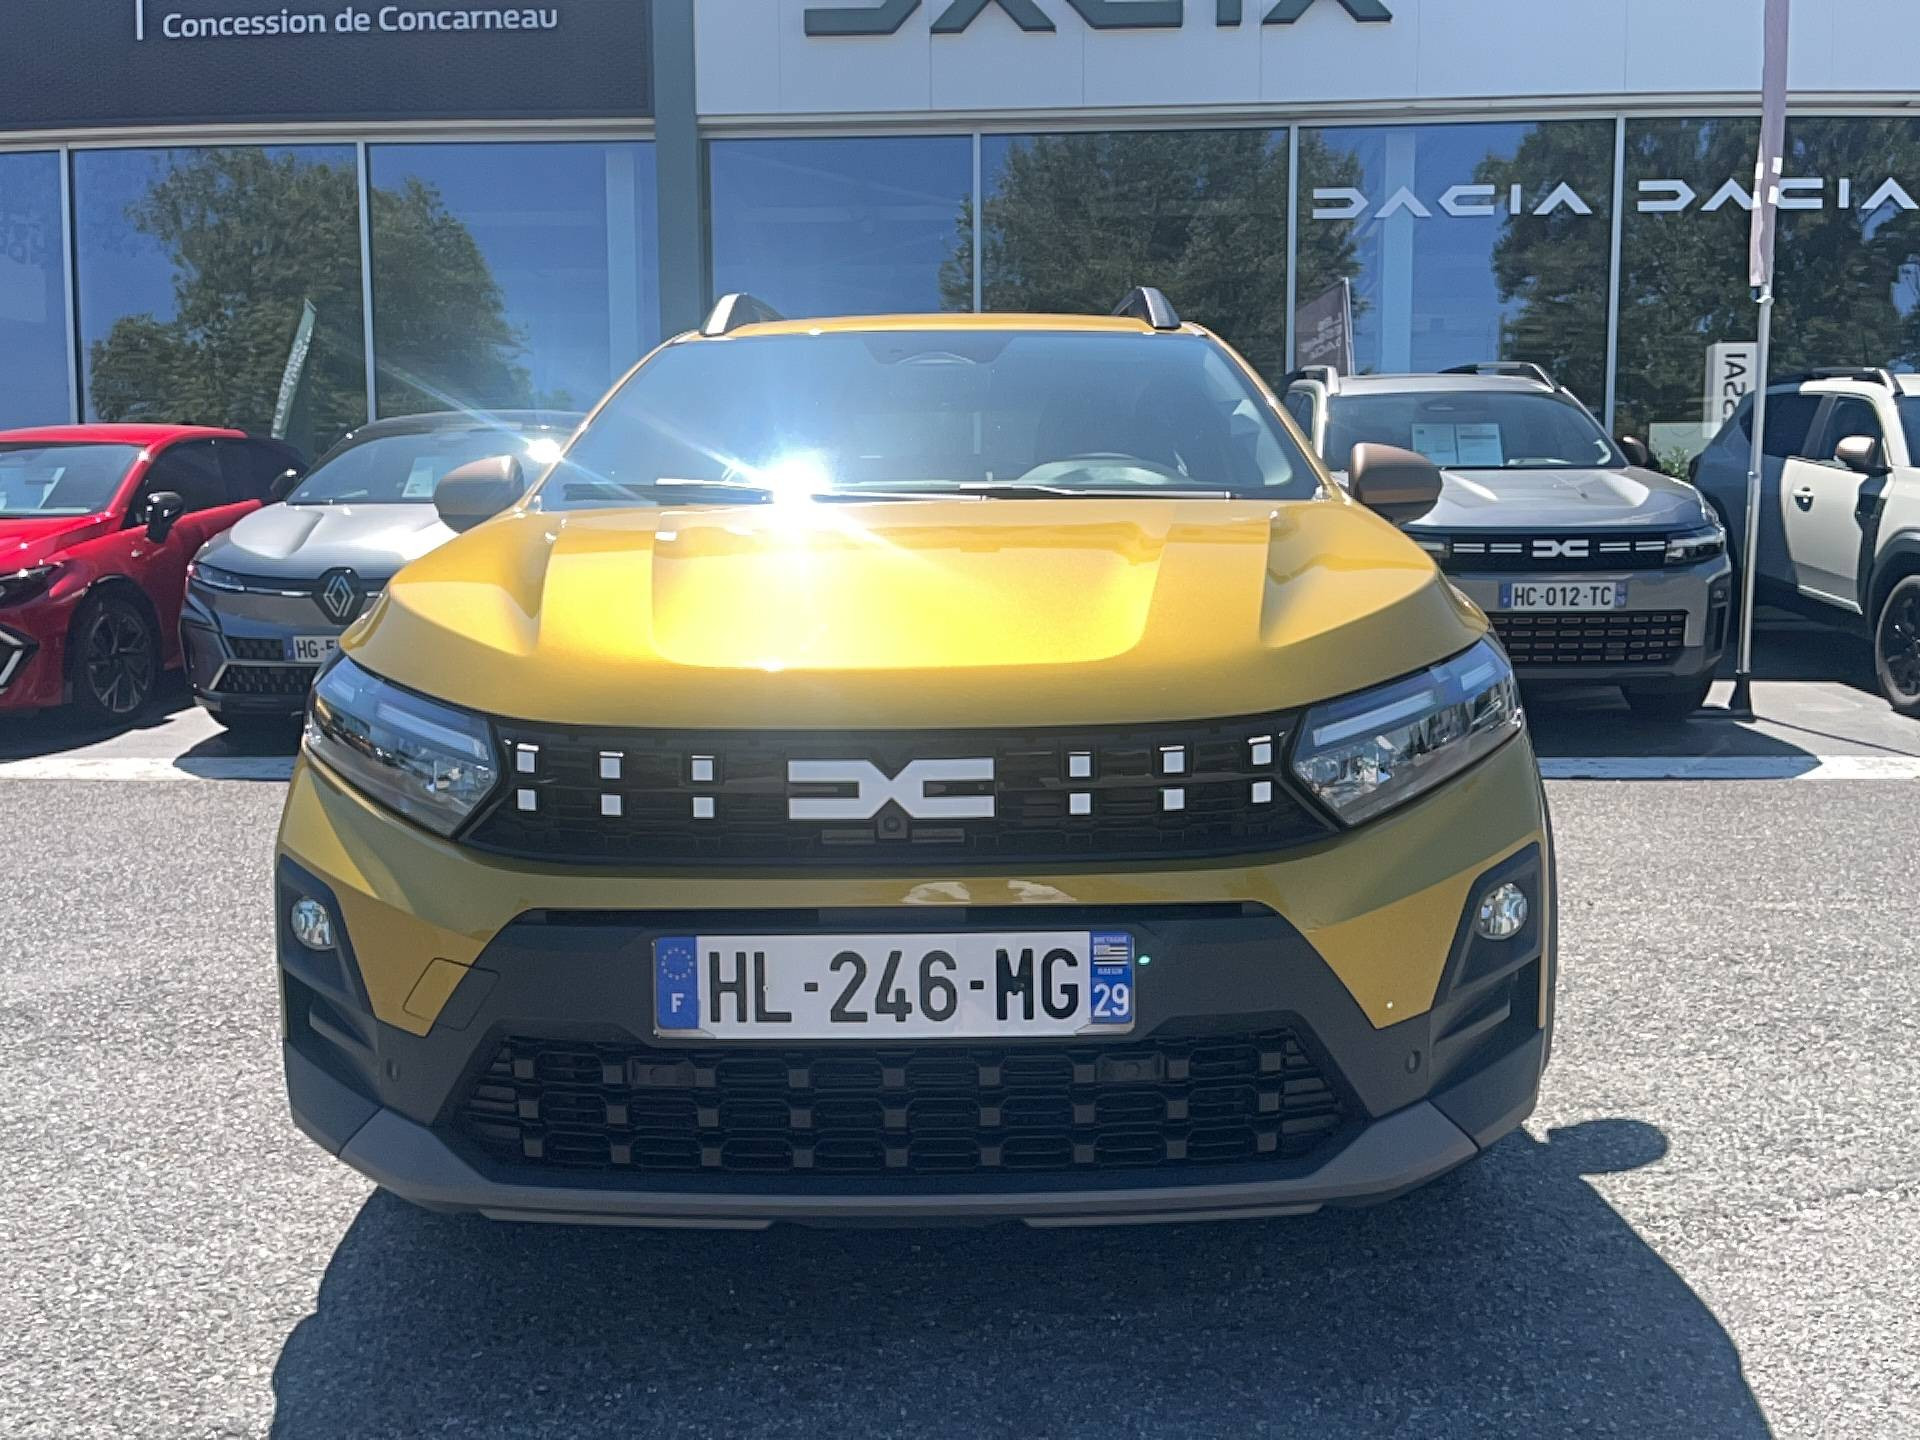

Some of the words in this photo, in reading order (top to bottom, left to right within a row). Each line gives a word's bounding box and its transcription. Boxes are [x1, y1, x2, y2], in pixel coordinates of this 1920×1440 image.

[162, 9, 327, 38] Concession
[334, 7, 371, 33] de
[378, 6, 559, 32] Concarneau
[1312, 181, 1593, 220] DACIA
[1637, 176, 1919, 212] DACIA
[1513, 586, 1612, 607] HC-012-TC
[671, 992, 685, 1014] F
[708, 947, 1080, 1024] HL-246-MG
[1094, 982, 1130, 1017] 29
